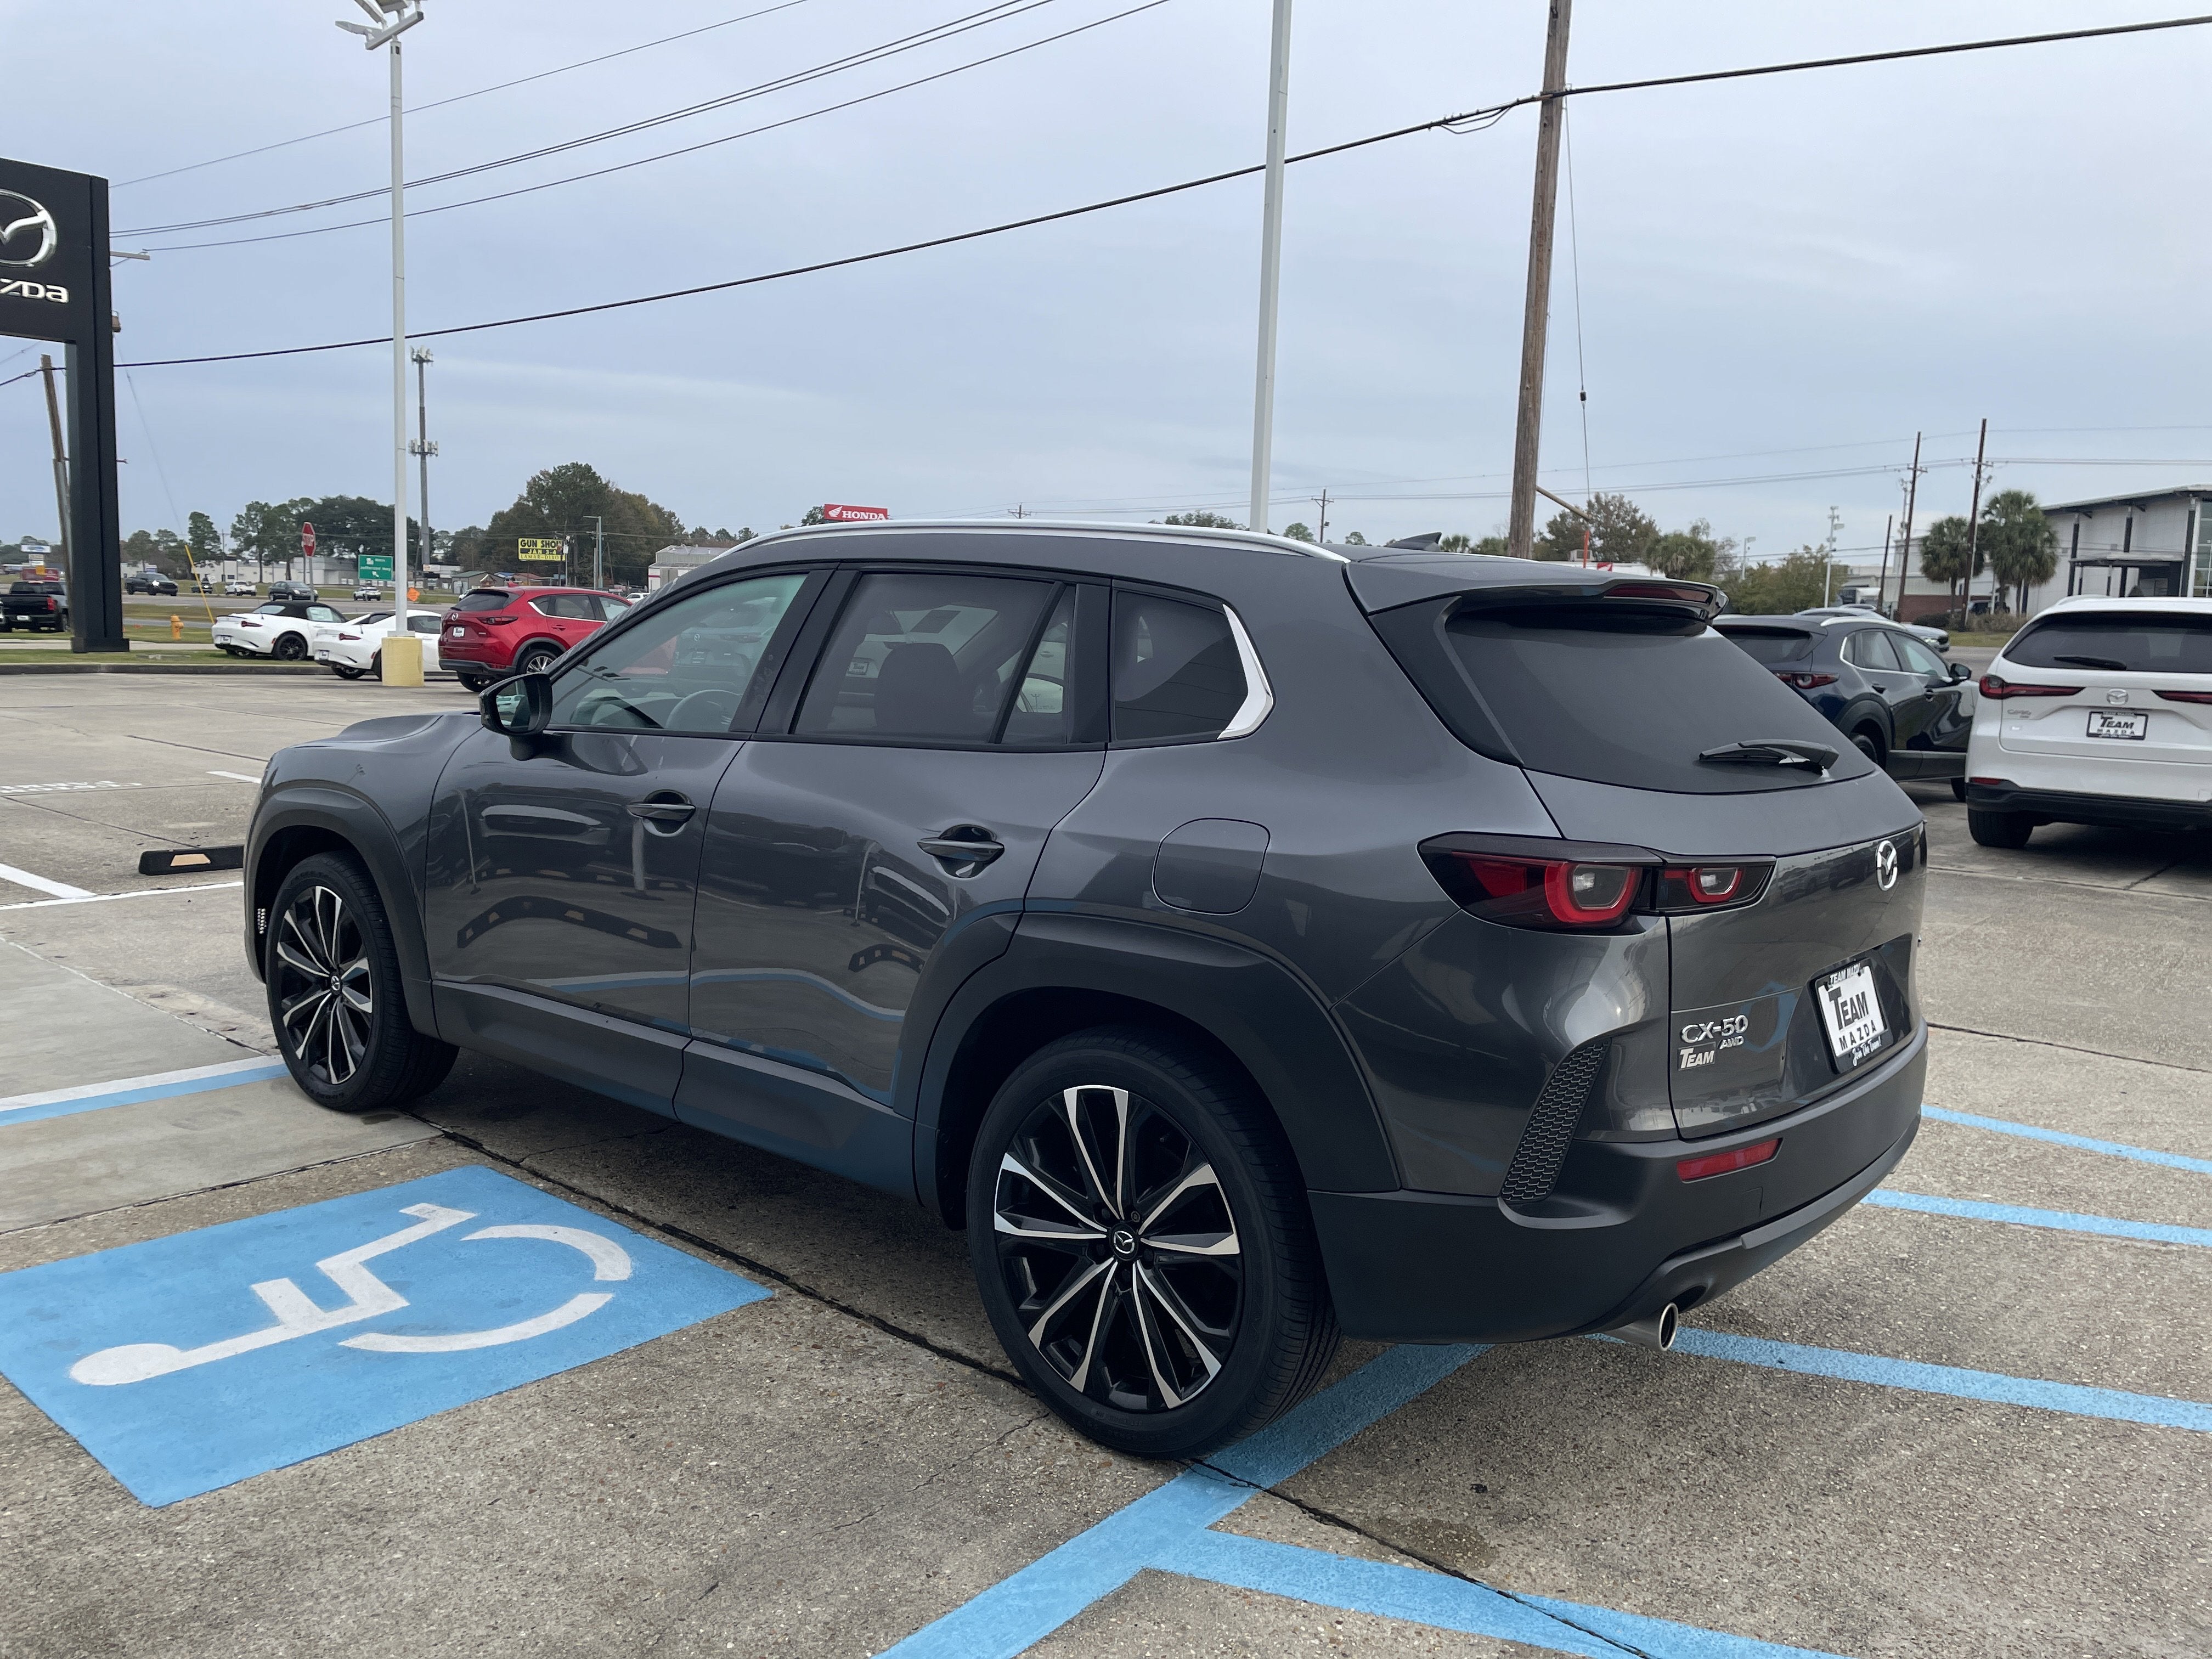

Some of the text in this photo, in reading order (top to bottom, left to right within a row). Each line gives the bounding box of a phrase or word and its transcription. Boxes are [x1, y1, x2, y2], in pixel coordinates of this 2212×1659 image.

[842, 510, 886, 521] HONDA
[520, 539, 538, 548] GUN
[2101, 716, 2134, 729] TEAM
[1830, 969, 1846, 984] TEAM
[1828, 986, 1869, 1030] TEAM
[1681, 1014, 1748, 1043] CX-50
[1839, 1020, 1877, 1051] MAZDA
[1719, 1036, 1744, 1049] AWD
[1680, 1047, 1715, 1069] TEAM
